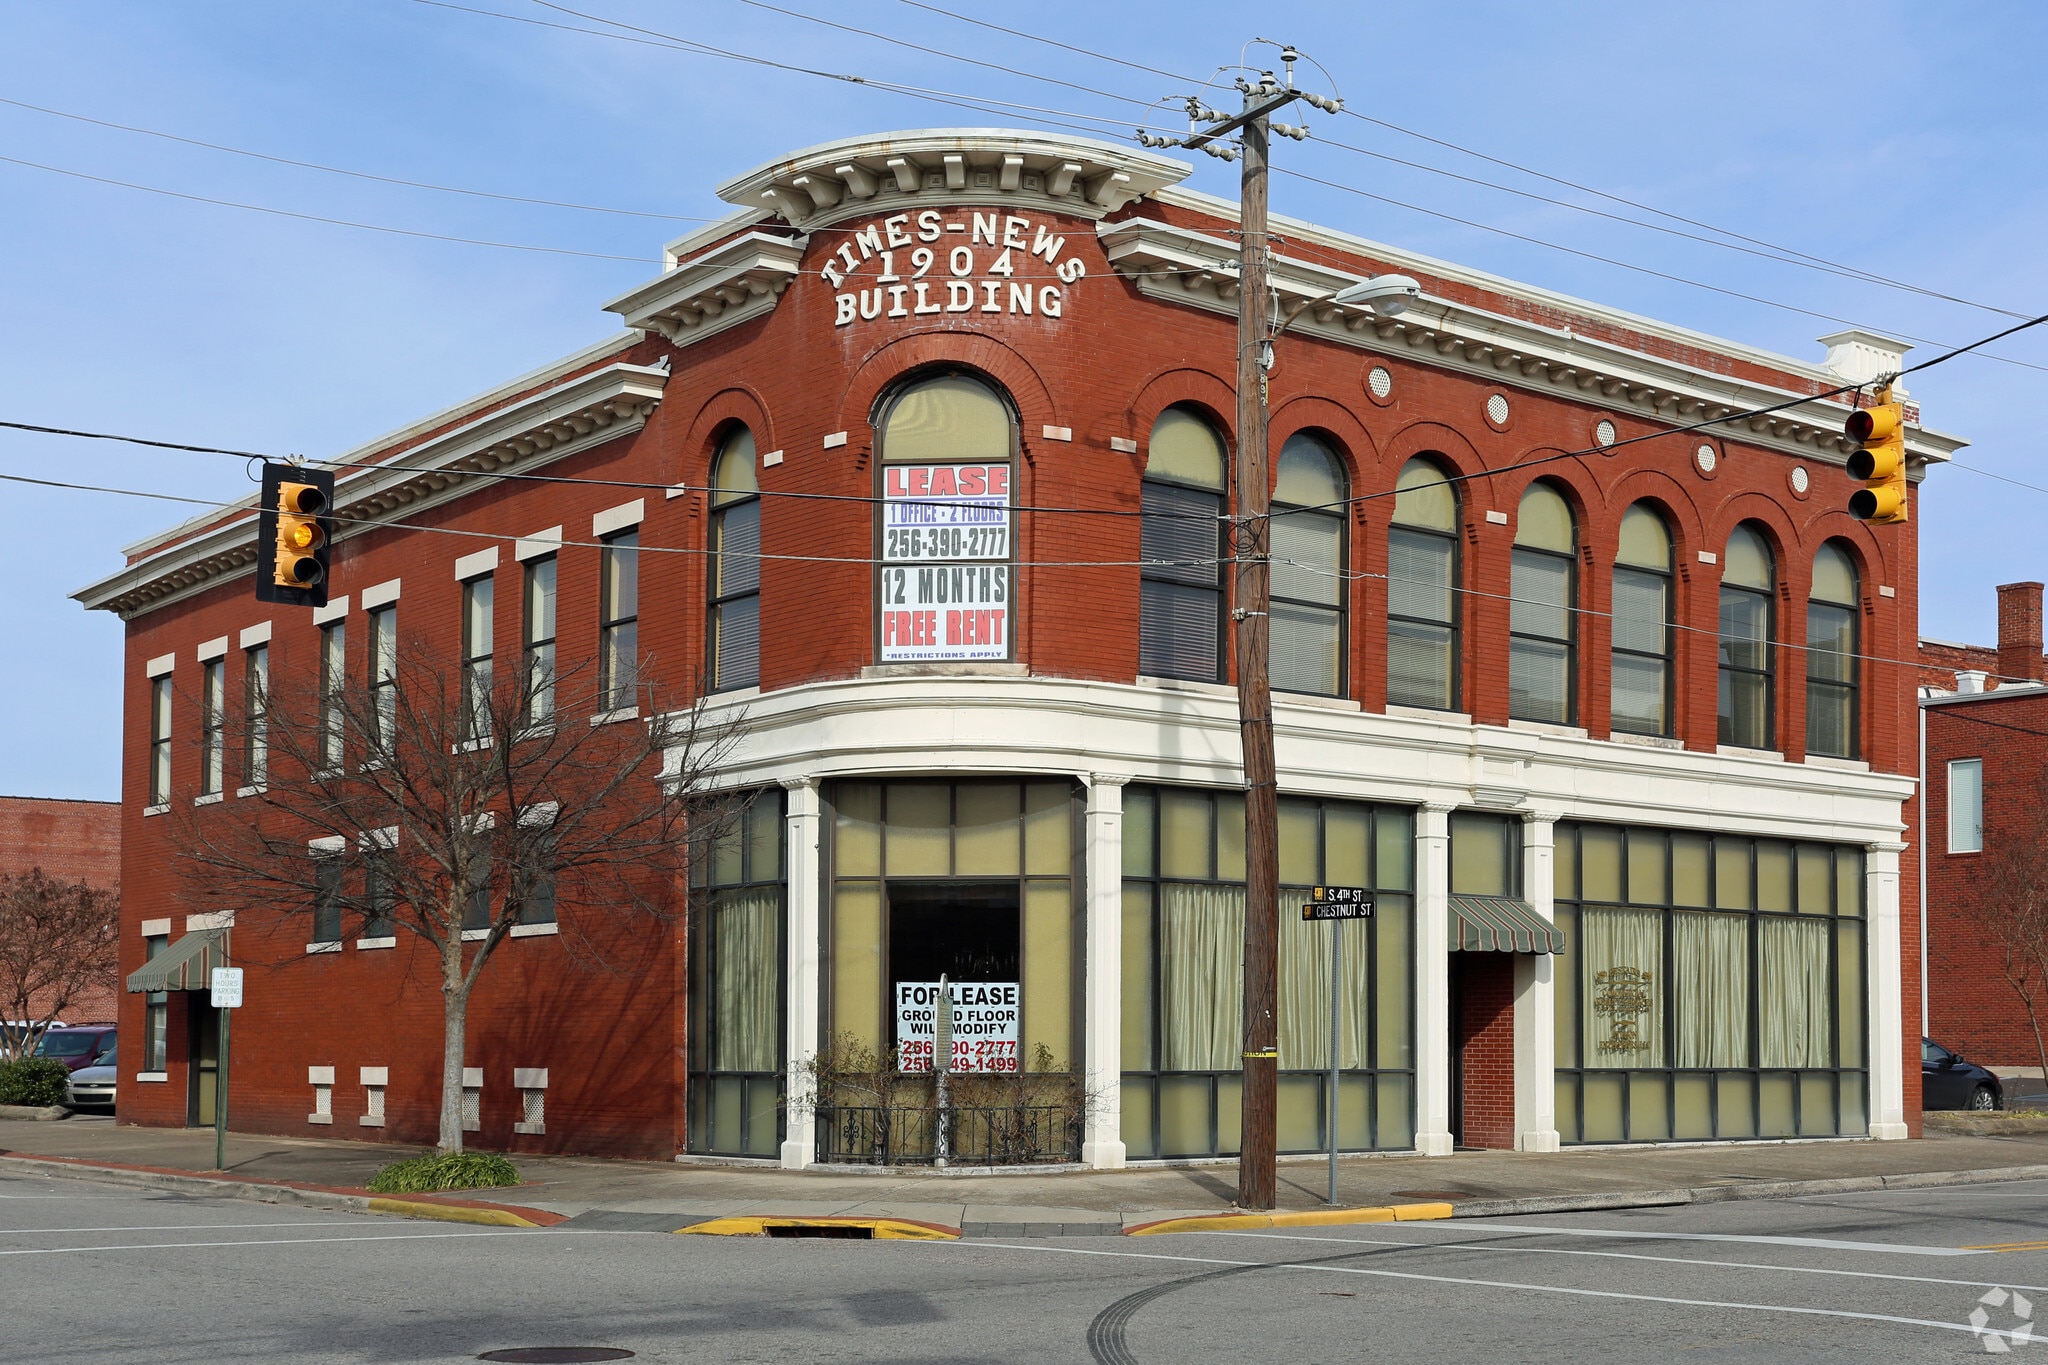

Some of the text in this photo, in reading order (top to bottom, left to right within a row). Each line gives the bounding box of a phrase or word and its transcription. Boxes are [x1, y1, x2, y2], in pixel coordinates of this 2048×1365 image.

[820, 210, 1086, 289] TIMES-NEWS
[877, 246, 1014, 283] 1904
[835, 281, 1062, 326] BUILDING
[887, 467, 1008, 496] LEASE
[900, 502, 937, 523] OFFICE
[950, 502, 957, 522] 2
[962, 501, 1004, 522] FLOORS
[888, 528, 1007, 557] 256-390-2777
[884, 567, 1005, 604] 12 MONTHS
[884, 609, 1005, 647] FREE RENT
[1316, 903, 1357, 917] CHESTNUT
[1360, 903, 1371, 916] ST
[1352, 889, 1362, 902] ST
[948, 987, 1015, 1005] LEASE
[902, 1010, 1015, 1021] GROD FLOOR
[910, 1023, 1007, 1034] WIL MODIFY
